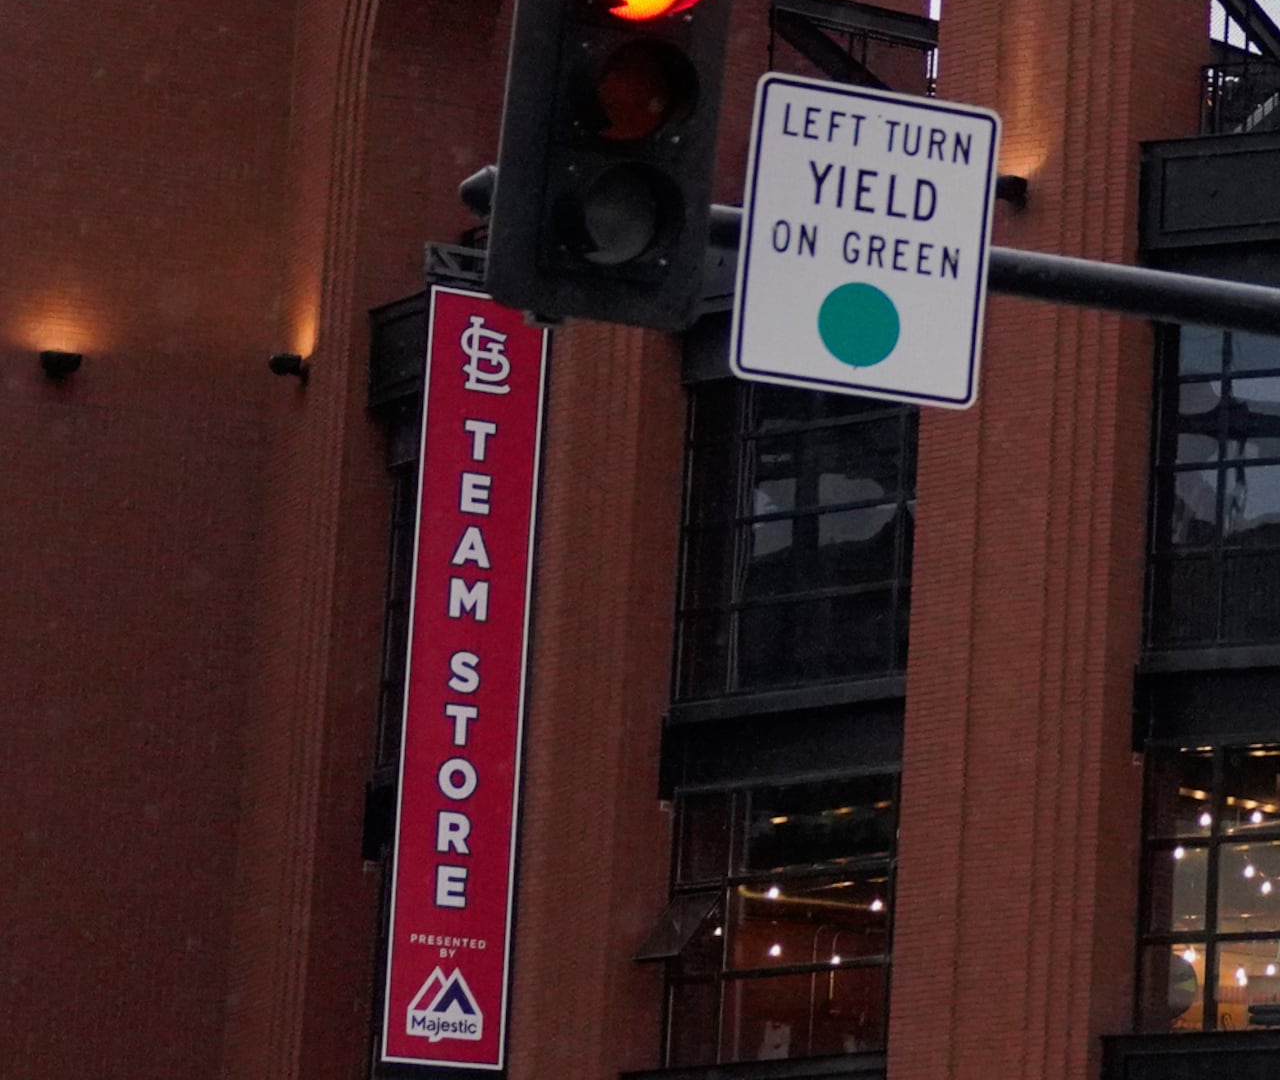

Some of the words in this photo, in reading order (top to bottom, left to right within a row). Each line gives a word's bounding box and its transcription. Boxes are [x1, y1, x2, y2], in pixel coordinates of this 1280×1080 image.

[782, 103, 866, 146] LEFT
[885, 120, 973, 165] TURN
[809, 160, 938, 222] YIELD
[772, 220, 818, 258] ON
[843, 231, 960, 280] GREEN
[447, 418, 498, 623] TEAM
[434, 650, 482, 909] STORE
[409, 933, 487, 950] PRESENTED
[439, 947, 457, 958] BY
[411, 1015, 477, 1036] Majestic
